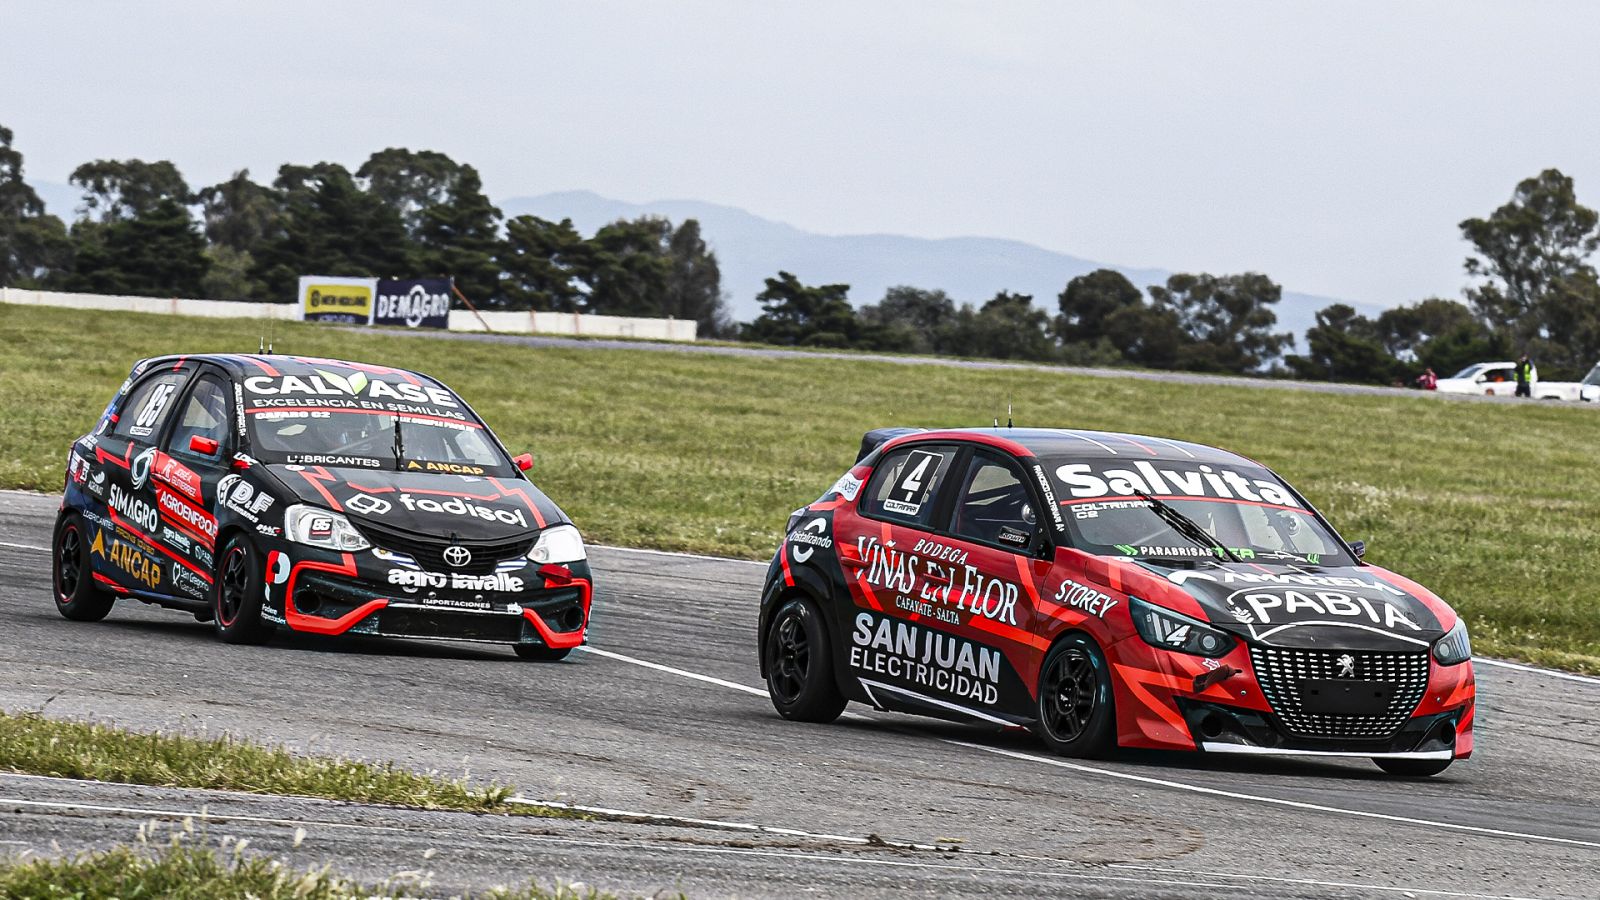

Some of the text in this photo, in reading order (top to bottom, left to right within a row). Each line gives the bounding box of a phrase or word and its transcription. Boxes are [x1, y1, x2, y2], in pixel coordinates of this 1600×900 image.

[377, 292, 450, 319] DEMAGRO
[136, 384, 176, 428] 85
[243, 369, 459, 409] CALVASE
[253, 398, 466, 421] EXCELENCIA EN SEMILLAS
[426, 462, 485, 476] ANCAP
[901, 455, 932, 502] 4
[1055, 461, 1300, 508] Salvita
[107, 483, 159, 533] SIMAGRO
[312, 519, 333, 531] 85
[400, 493, 529, 528] fadisol
[789, 530, 833, 549] Cristalizando
[913, 538, 969, 565] BODEGA
[1140, 546, 1213, 557] PARABRISAS
[110, 538, 161, 589] ANCAP
[387, 568, 524, 594] agro lavalle
[855, 535, 1019, 626] VIÑAS EN FLOR
[423, 598, 491, 609] IMPORTACIONES
[895, 595, 932, 617] CAFAYATE
[936, 607, 960, 625] SALTA
[1055, 579, 1119, 618] STOREY
[1244, 590, 1422, 631] PABIA
[852, 612, 1001, 684] SAN JUAN
[849, 646, 999, 705] ELECTRICIDAD
